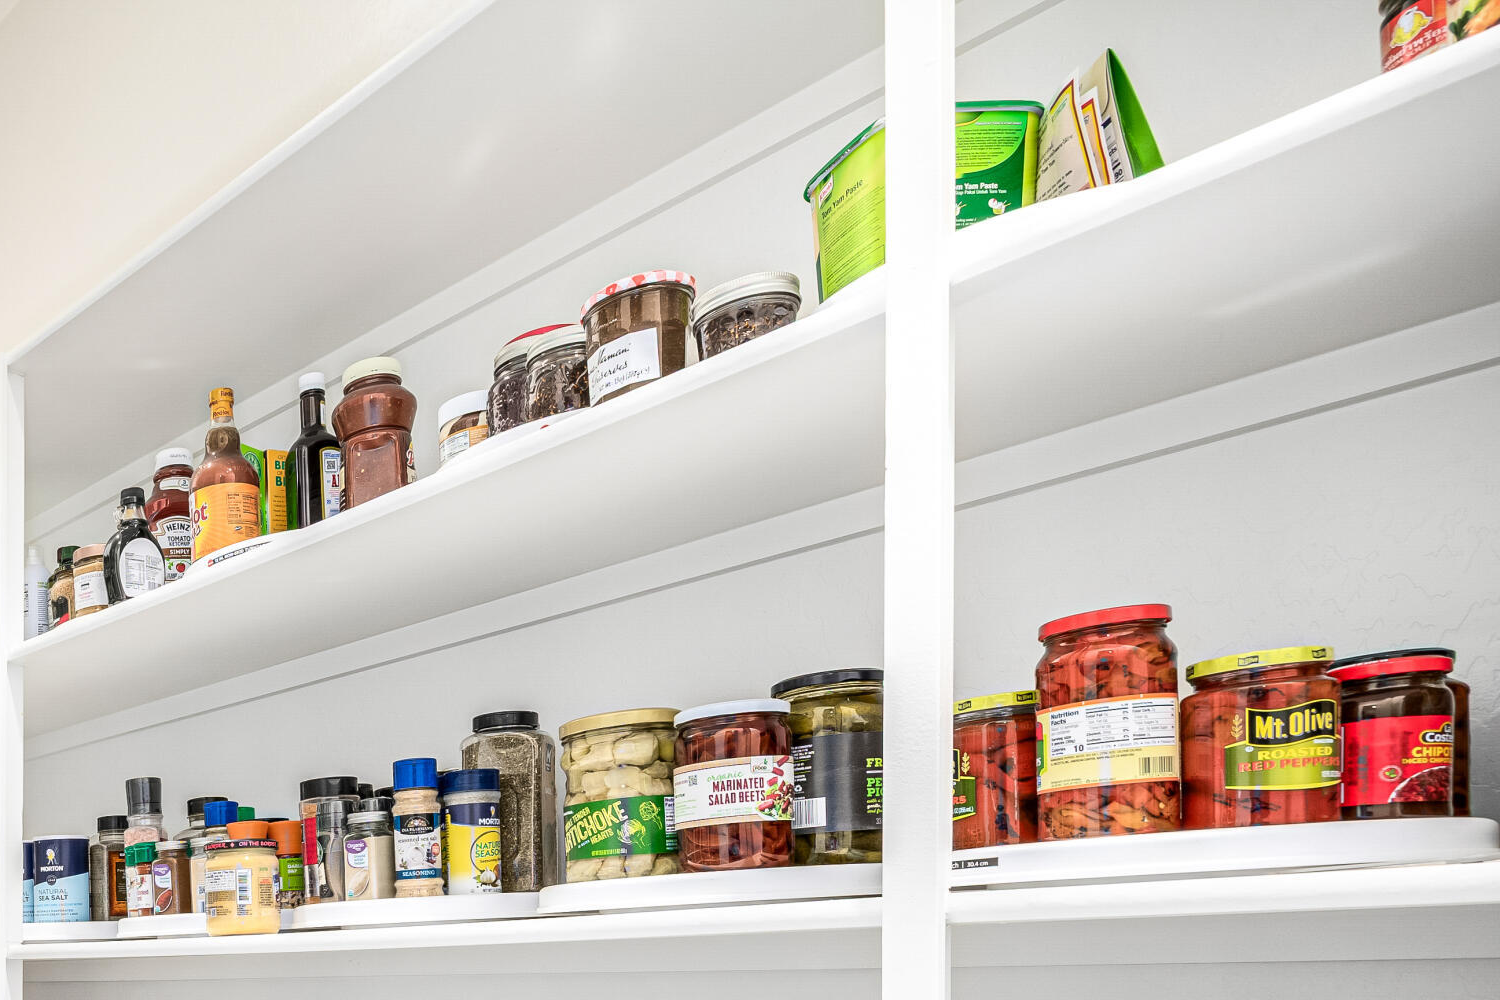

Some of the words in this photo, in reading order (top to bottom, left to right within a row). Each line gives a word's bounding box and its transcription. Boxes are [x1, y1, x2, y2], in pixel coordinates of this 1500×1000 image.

[964, 182, 978, 190] Yam
[821, 208, 832, 220] Tom
[832, 196, 845, 209] Yam
[845, 178, 863, 197] Paste
[165, 523, 191, 532] HEINZ
[1050, 709, 1080, 721] Nutrition
[1050, 718, 1067, 726] Facts
[1255, 715, 1287, 739] Mt.
[1289, 708, 1333, 737] Olive
[1073, 744, 1084, 753] 10
[1257, 746, 1333, 762] ROASTED
[1237, 758, 1278, 773] RED
[706, 771, 743, 783] organic
[712, 776, 765, 793] MARINATED
[708, 793, 737, 807] SALAD
[738, 790, 766, 804] BEETS
[573, 806, 591, 824] TENDER
[590, 828, 614, 845] HEARTS
[40, 865, 64, 873] MORTON
[402, 869, 436, 877] SEASONING
